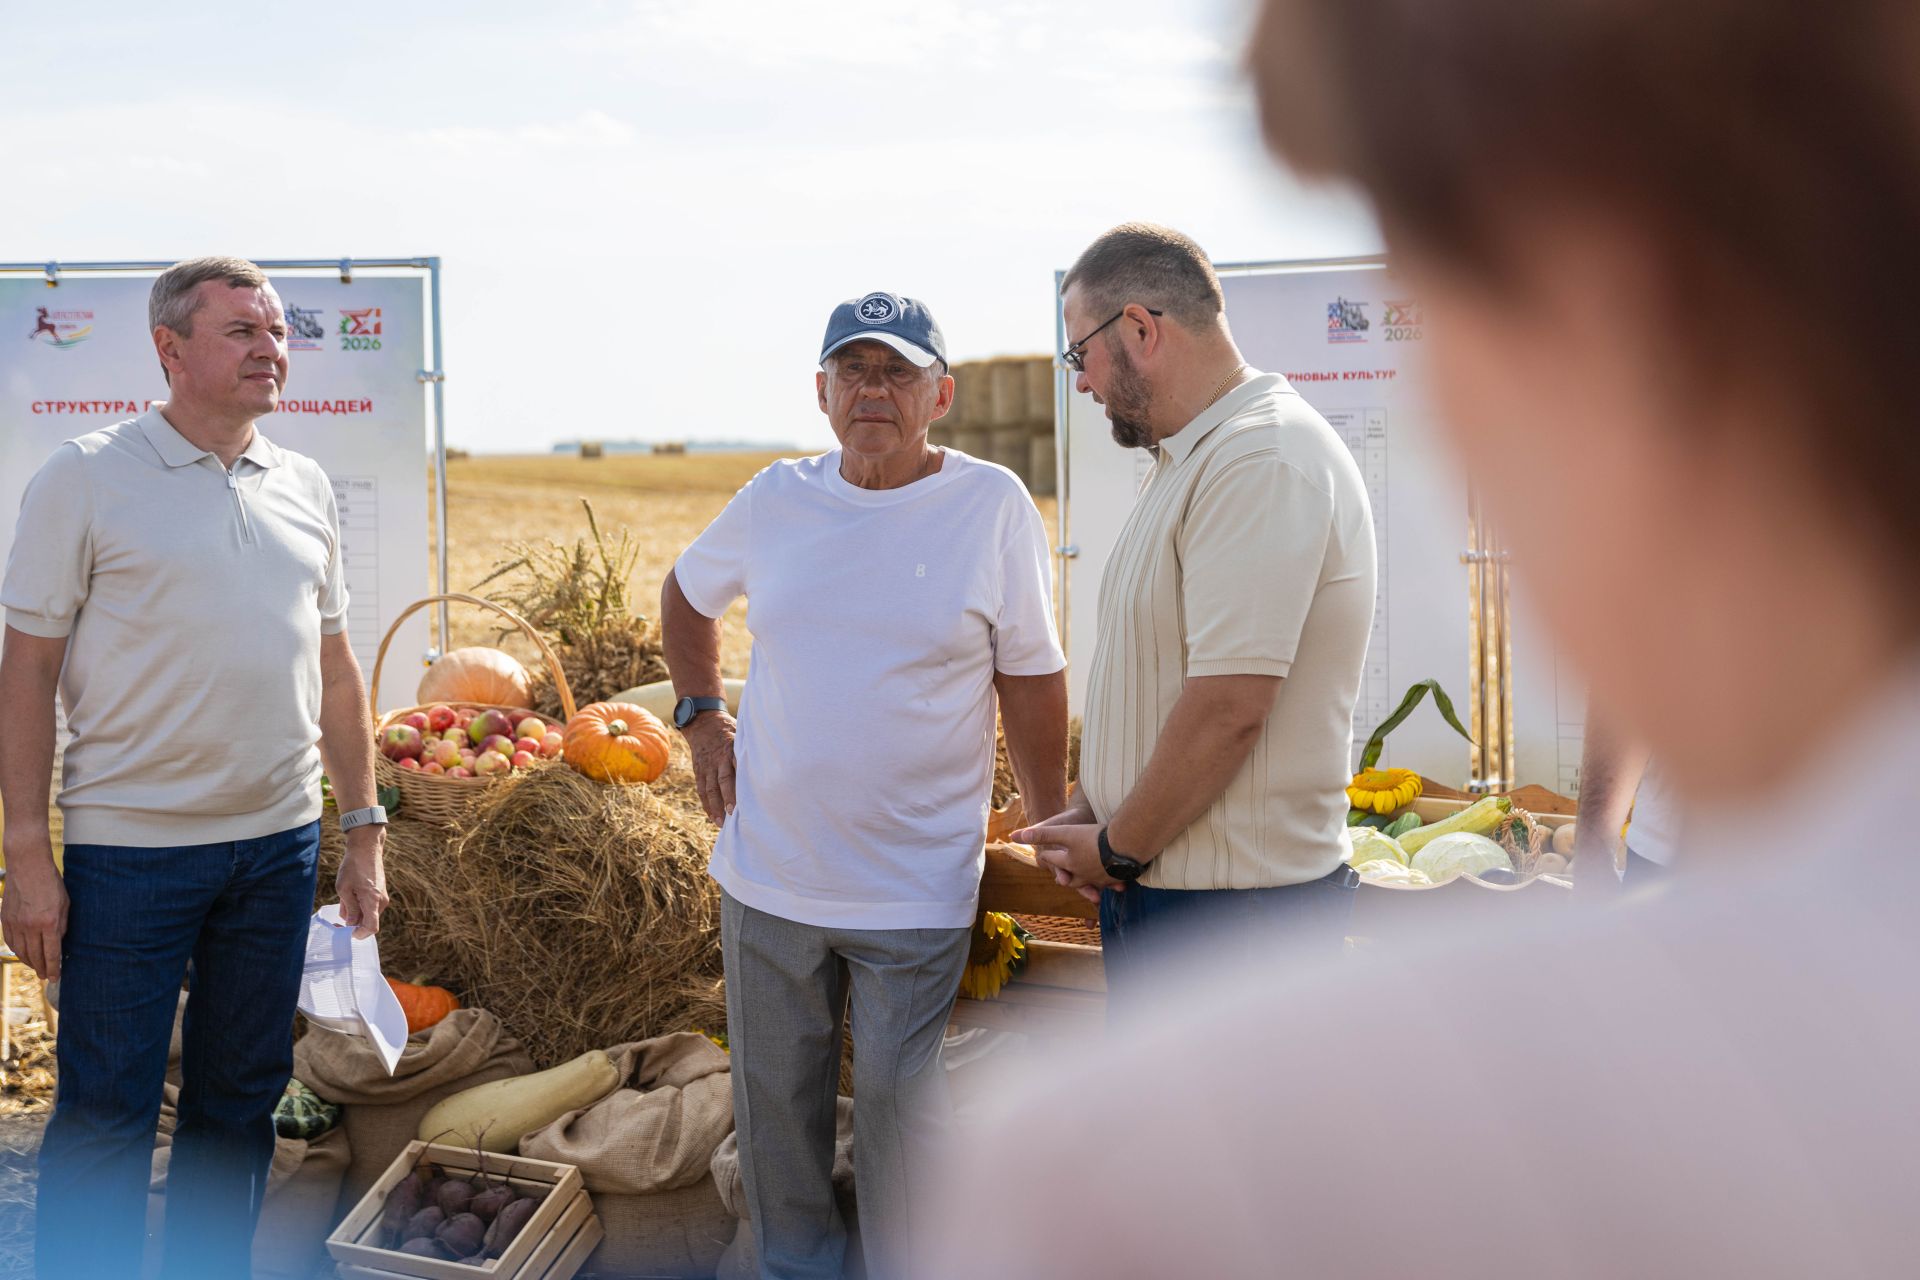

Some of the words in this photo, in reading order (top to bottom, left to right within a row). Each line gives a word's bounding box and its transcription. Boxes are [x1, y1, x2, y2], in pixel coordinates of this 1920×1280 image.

[1384, 327, 1423, 342] 2026
[341, 336, 382, 351] 2026
[1286, 372, 1339, 382] РНОВЫХ
[1343, 370, 1397, 380] КУЛЬТУР
[31, 400, 138, 414] СТРУКТУРА
[273, 397, 373, 416] ЛОЩАДЕЙ
